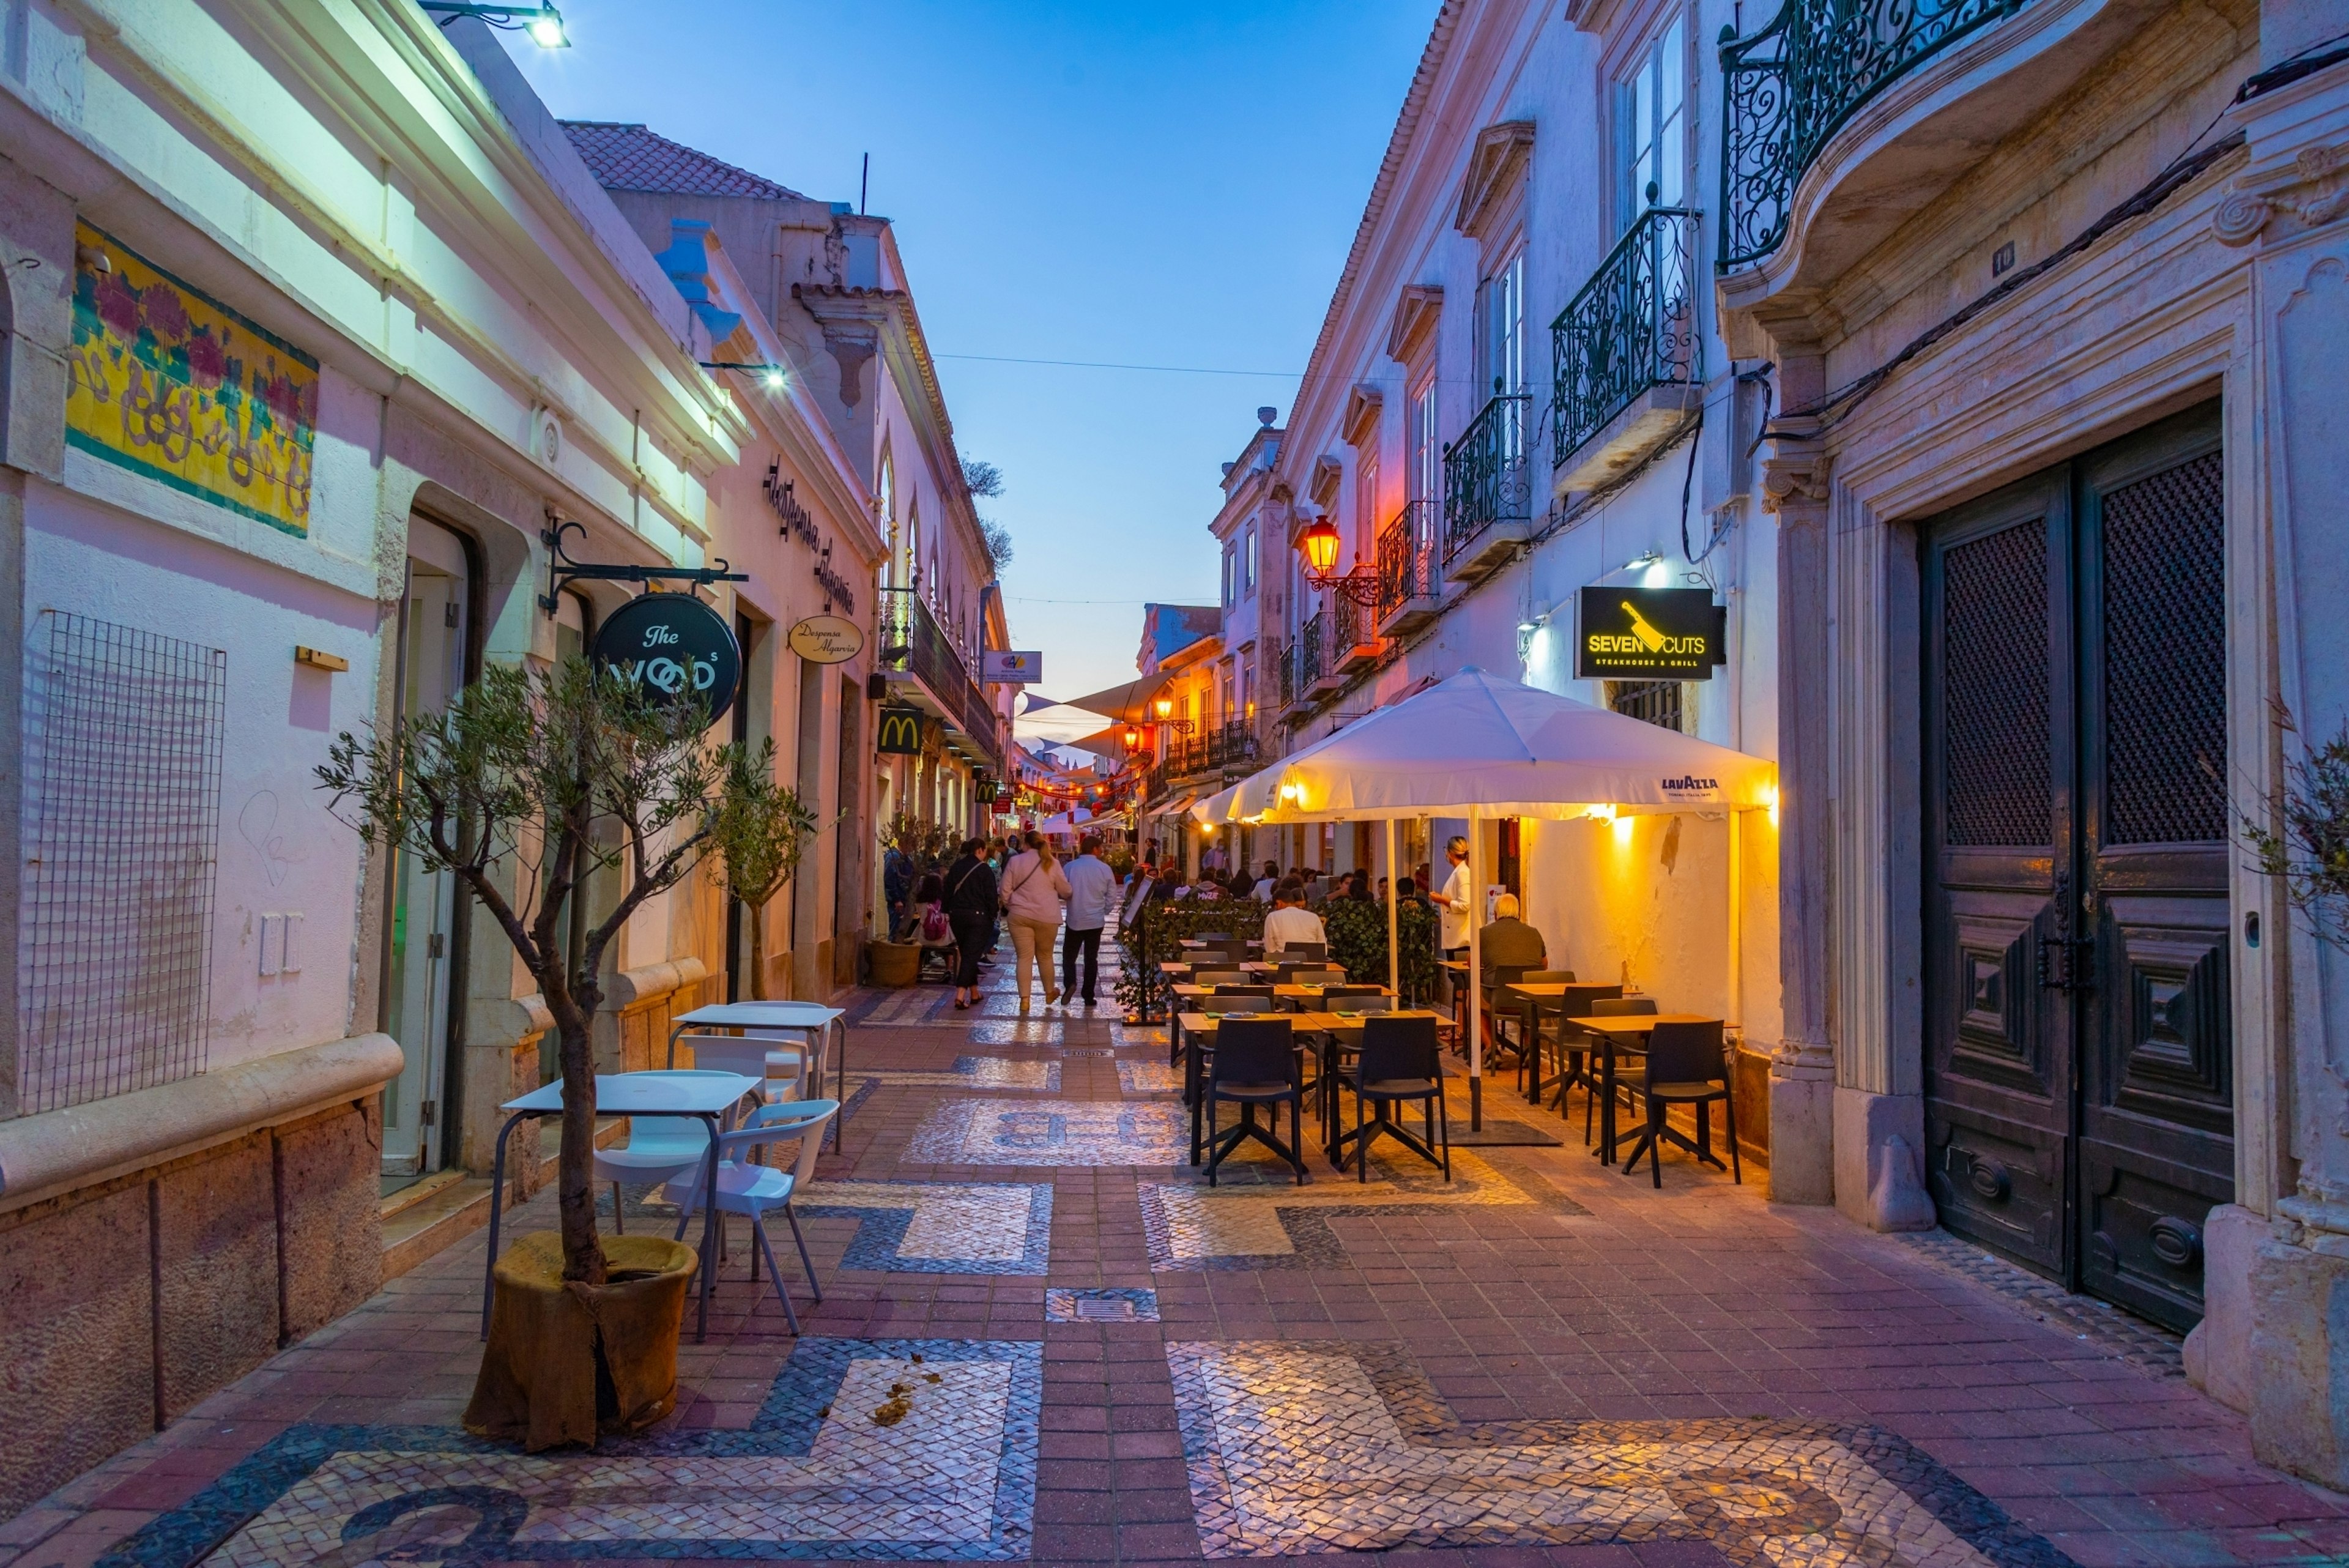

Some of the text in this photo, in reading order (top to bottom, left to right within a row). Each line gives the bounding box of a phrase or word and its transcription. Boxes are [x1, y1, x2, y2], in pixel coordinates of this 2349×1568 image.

[1996, 248, 2010, 272] 10
[643, 625, 678, 647] The
[798, 623, 841, 640] Despensa
[813, 639, 855, 655] Algarvia
[1589, 635, 1705, 654] SEVEN CUTS
[1662, 775, 1718, 789] LAVAZZA
